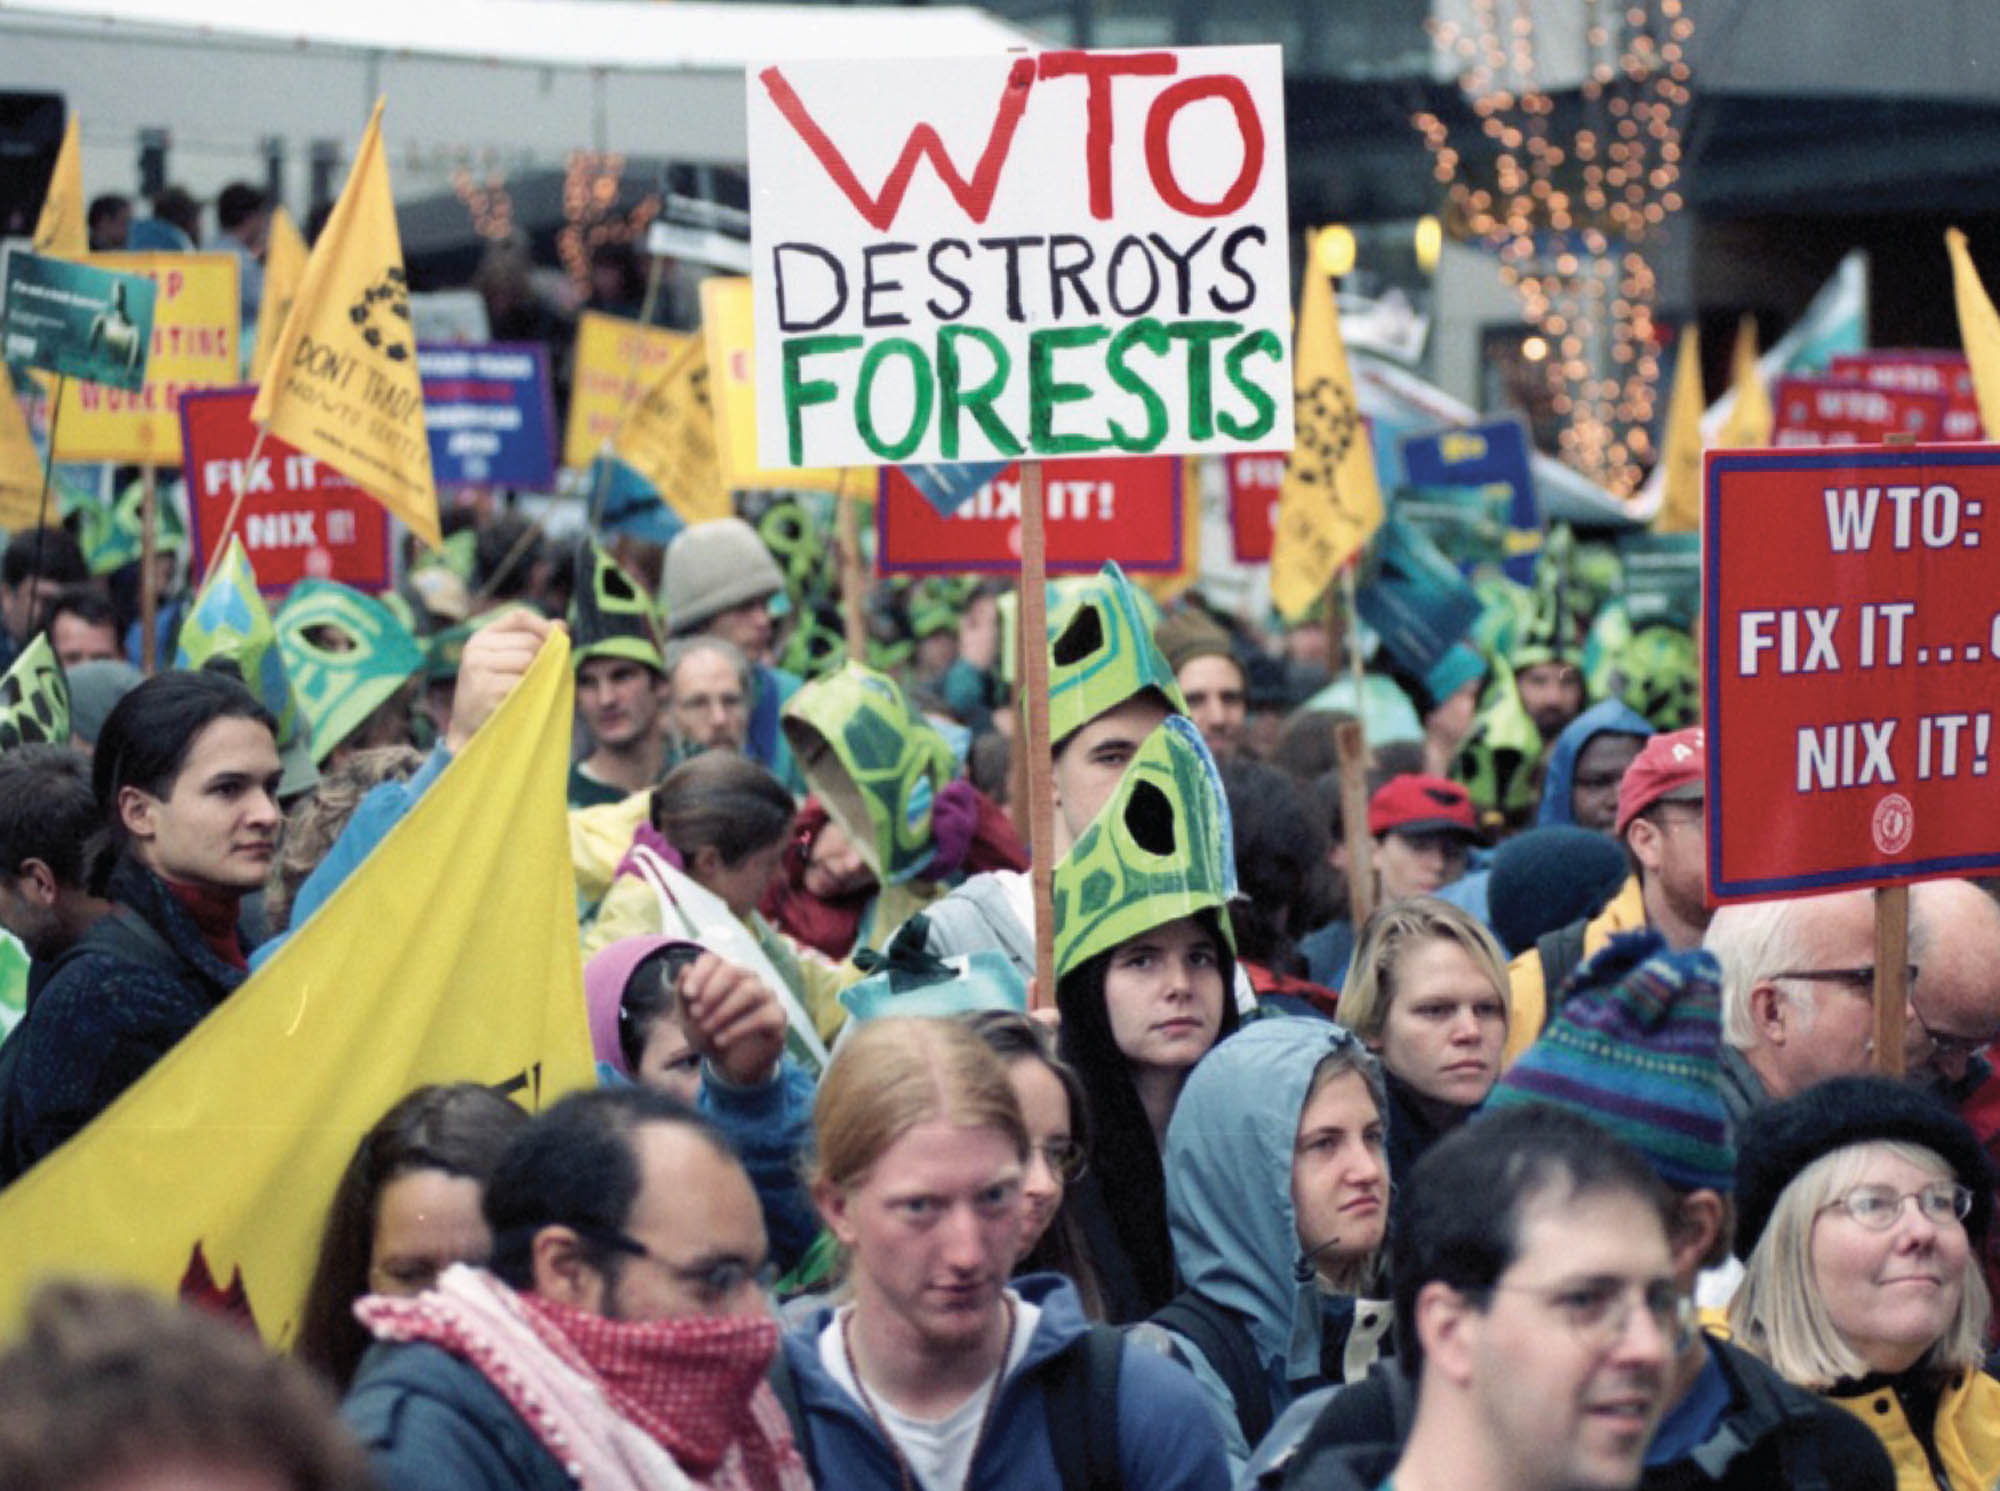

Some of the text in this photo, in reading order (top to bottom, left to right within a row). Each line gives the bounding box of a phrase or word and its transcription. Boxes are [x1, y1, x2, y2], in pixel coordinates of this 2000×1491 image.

[759, 49, 1265, 232] WTO
[773, 225, 1266, 332] DESTROYS
[782, 316, 1284, 467] FORESTS
[205, 458, 273, 496] FIX
[1047, 480, 1114, 520] IT!
[246, 512, 315, 548] NIX
[1823, 484, 1981, 551] WTO:
[1739, 607, 1841, 675] FIX
[1797, 713, 1990, 791] NIX IT!
